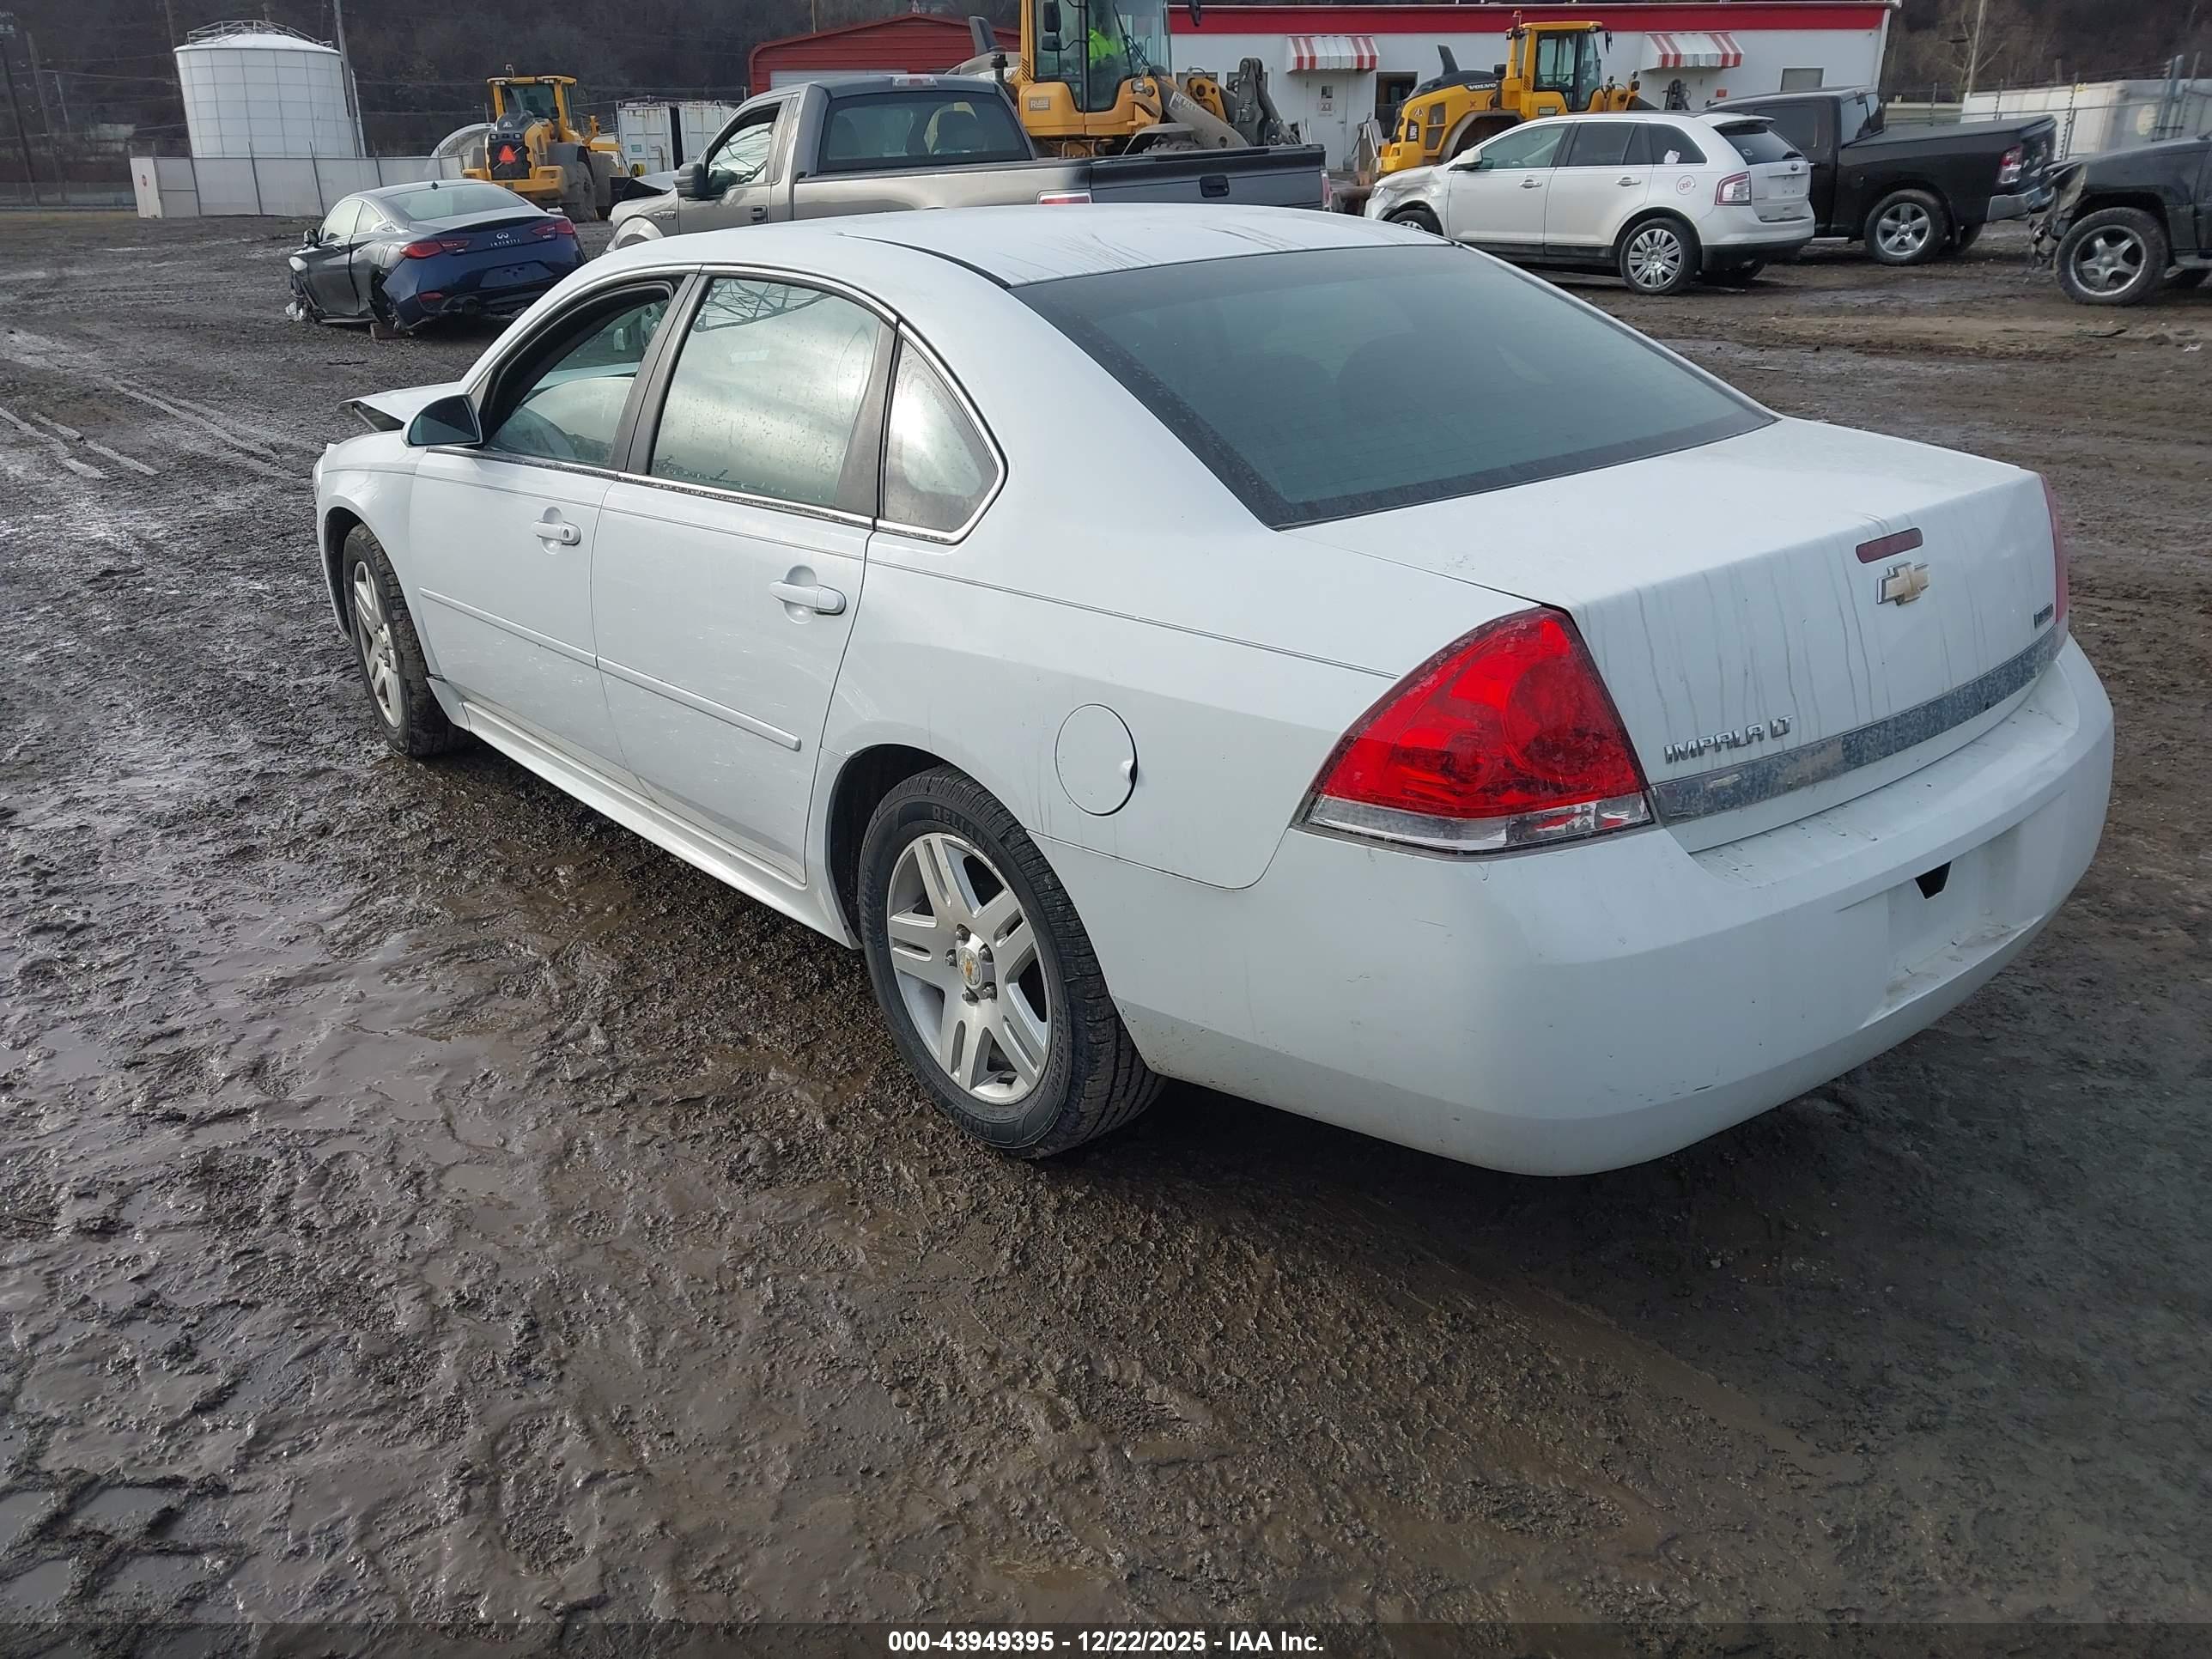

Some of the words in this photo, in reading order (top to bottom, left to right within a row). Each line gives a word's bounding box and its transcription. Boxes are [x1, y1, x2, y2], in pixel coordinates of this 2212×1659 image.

[489, 239, 520, 247] INFINITI
[1664, 724, 1765, 764] IMPALA
[1770, 714, 1794, 738] LT
